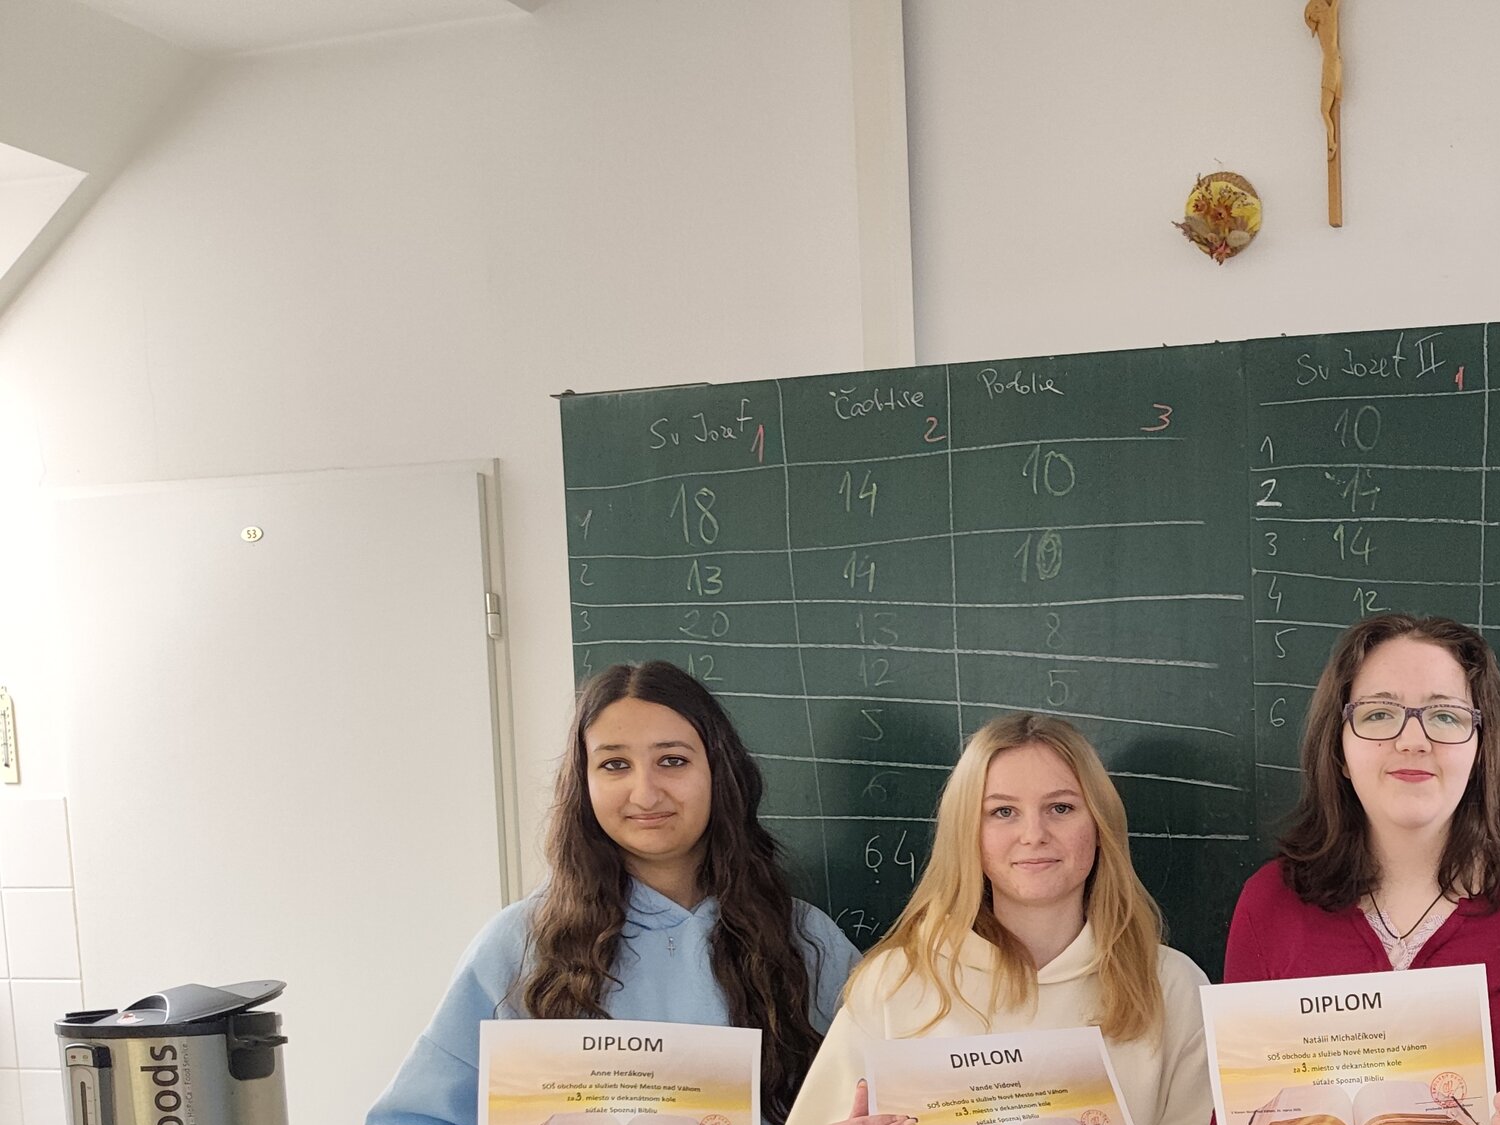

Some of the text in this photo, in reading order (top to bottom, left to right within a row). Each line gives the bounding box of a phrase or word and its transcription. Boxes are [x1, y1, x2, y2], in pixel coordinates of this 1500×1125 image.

[1454, 365, 1466, 392] 1
[923, 416, 948, 443] 2
[1139, 402, 1174, 432] 3
[1333, 403, 1383, 451] 10
[750, 422, 765, 464] 1
[1260, 435, 1274, 464] 1
[1022, 443, 1076, 496] 10
[838, 469, 878, 519] 14
[1255, 478, 1283, 508] 2
[579, 508, 593, 542] 1
[669, 479, 721, 545] 18
[246, 528, 258, 540] 53
[1264, 531, 1279, 556] 3
[1332, 523, 1379, 566] 14
[578, 563, 595, 588] 2
[686, 558, 724, 597] 13
[842, 550, 876, 593] 14
[1267, 575, 1283, 614] 4
[1352, 586, 1392, 619] 12
[579, 609, 592, 633] 3
[677, 609, 730, 640] 20
[855, 610, 900, 646] 13
[1046, 611, 1066, 651] 8
[1274, 626, 1299, 659] 5
[856, 654, 897, 688] 12
[1047, 668, 1081, 707] 5
[859, 708, 884, 742] 5
[1269, 696, 1287, 728] 6
[864, 829, 916, 884] 64
[1300, 992, 1383, 1014] DIPLOM
[582, 1035, 663, 1053] DIPLOM
[1267, 1052, 1280, 1061] SOŠ
[1281, 1051, 1311, 1060] obchodu
[1318, 1049, 1342, 1058] služieb
[1343, 1048, 1361, 1056] Nové
[1362, 1046, 1385, 1055] Mesto
[1386, 1045, 1400, 1053] nad
[1401, 1042, 1427, 1052] Váhom
[1303, 1030, 1386, 1045] Natálii Michalčíkovej
[950, 1048, 1024, 1069] DIPLOM
[1311, 1063, 1335, 1072] miesto
[1341, 1061, 1386, 1070] dekanátnom
[1386, 1059, 1402, 1067] kole
[1312, 1075, 1385, 1086] súťaže Spoznaj Bibliu
